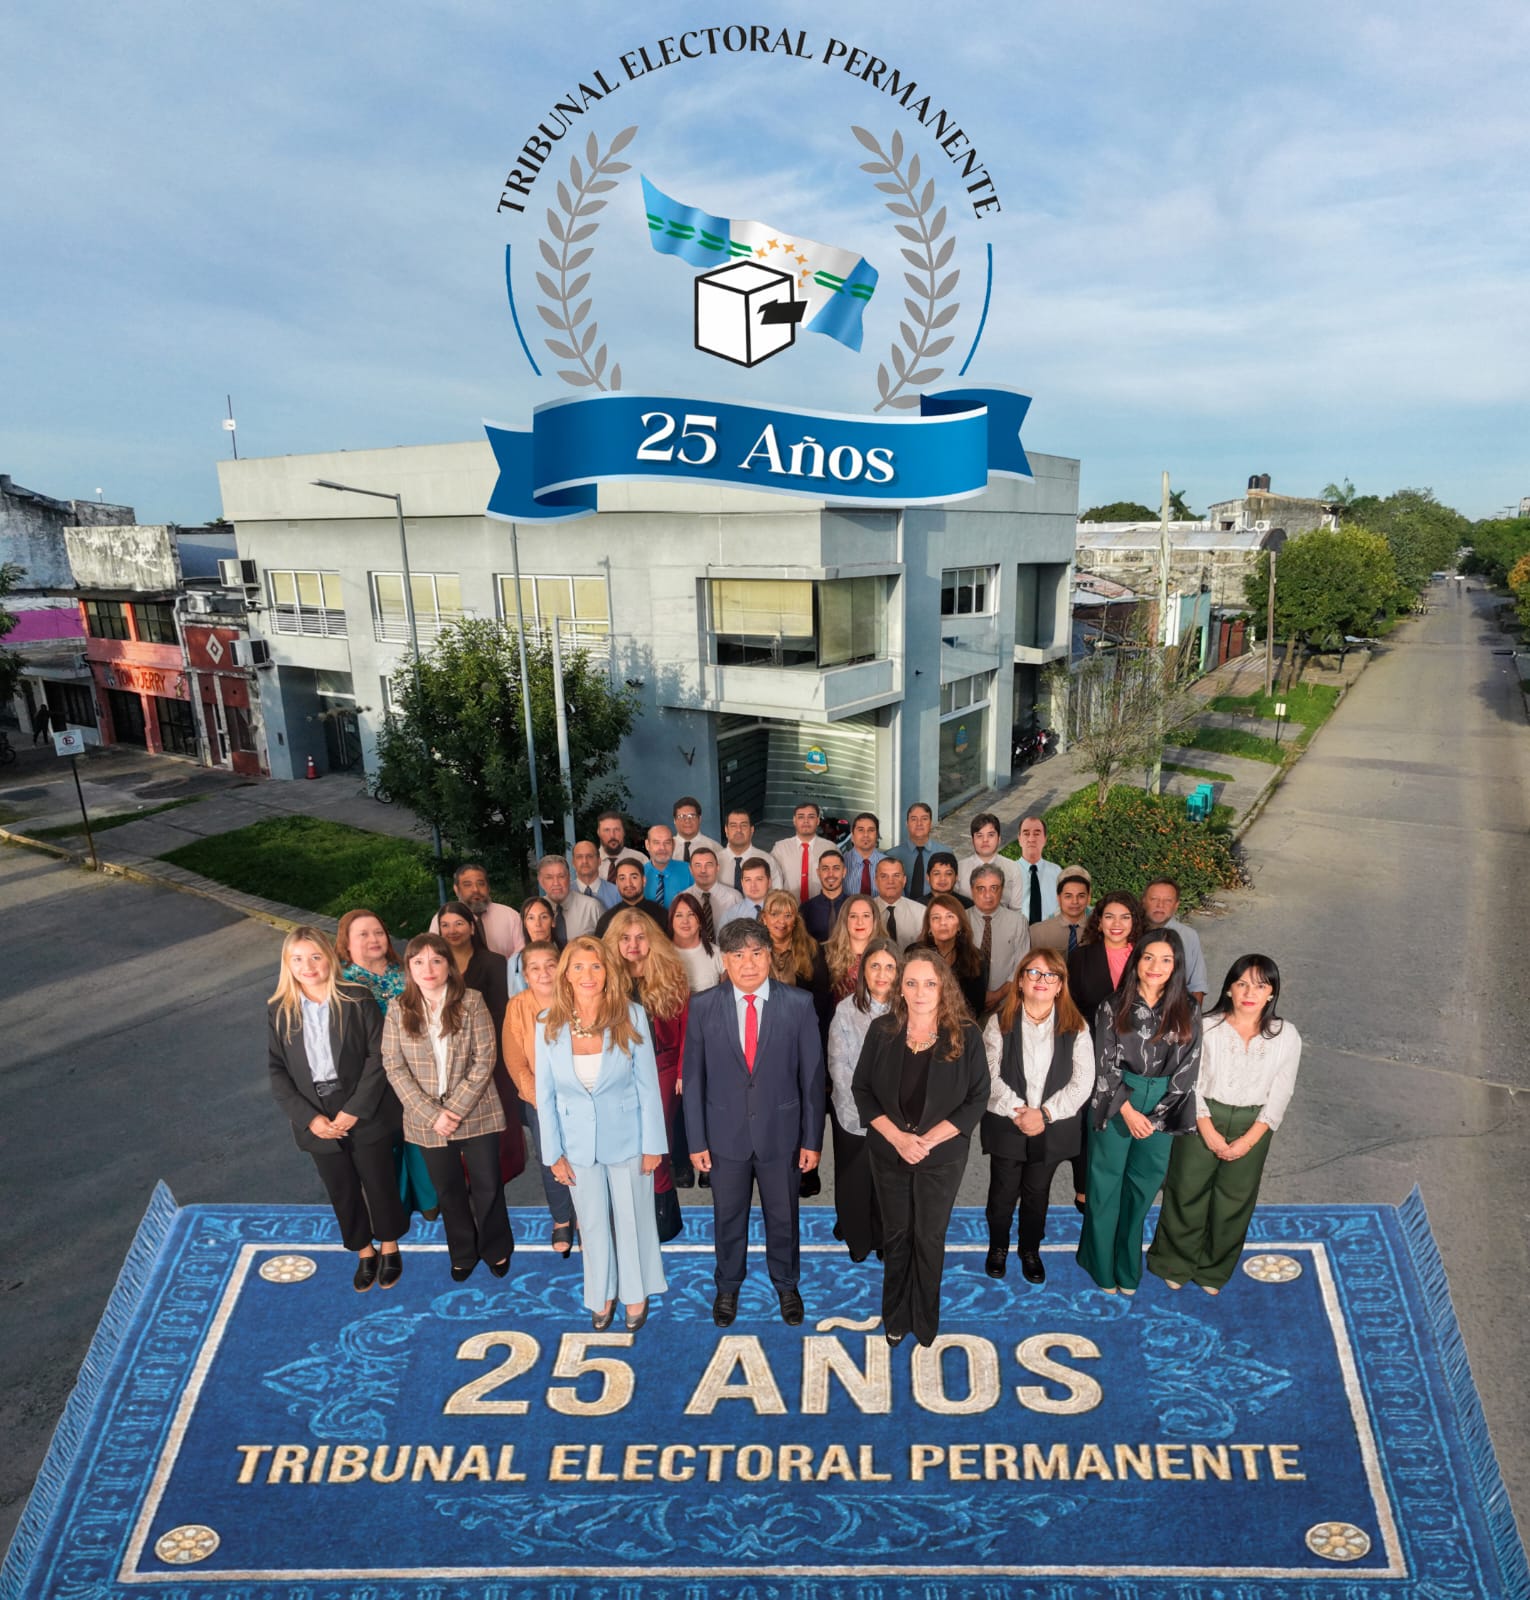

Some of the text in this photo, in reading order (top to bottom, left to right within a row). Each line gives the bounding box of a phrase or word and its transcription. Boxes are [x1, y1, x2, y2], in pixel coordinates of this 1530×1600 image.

[141, 671, 165, 693] JERRY
[442, 1315, 1103, 1416] 25 AÑOS
[236, 1442, 1307, 1484] TRIBUNAL ELECTORAL PERMANENTE
